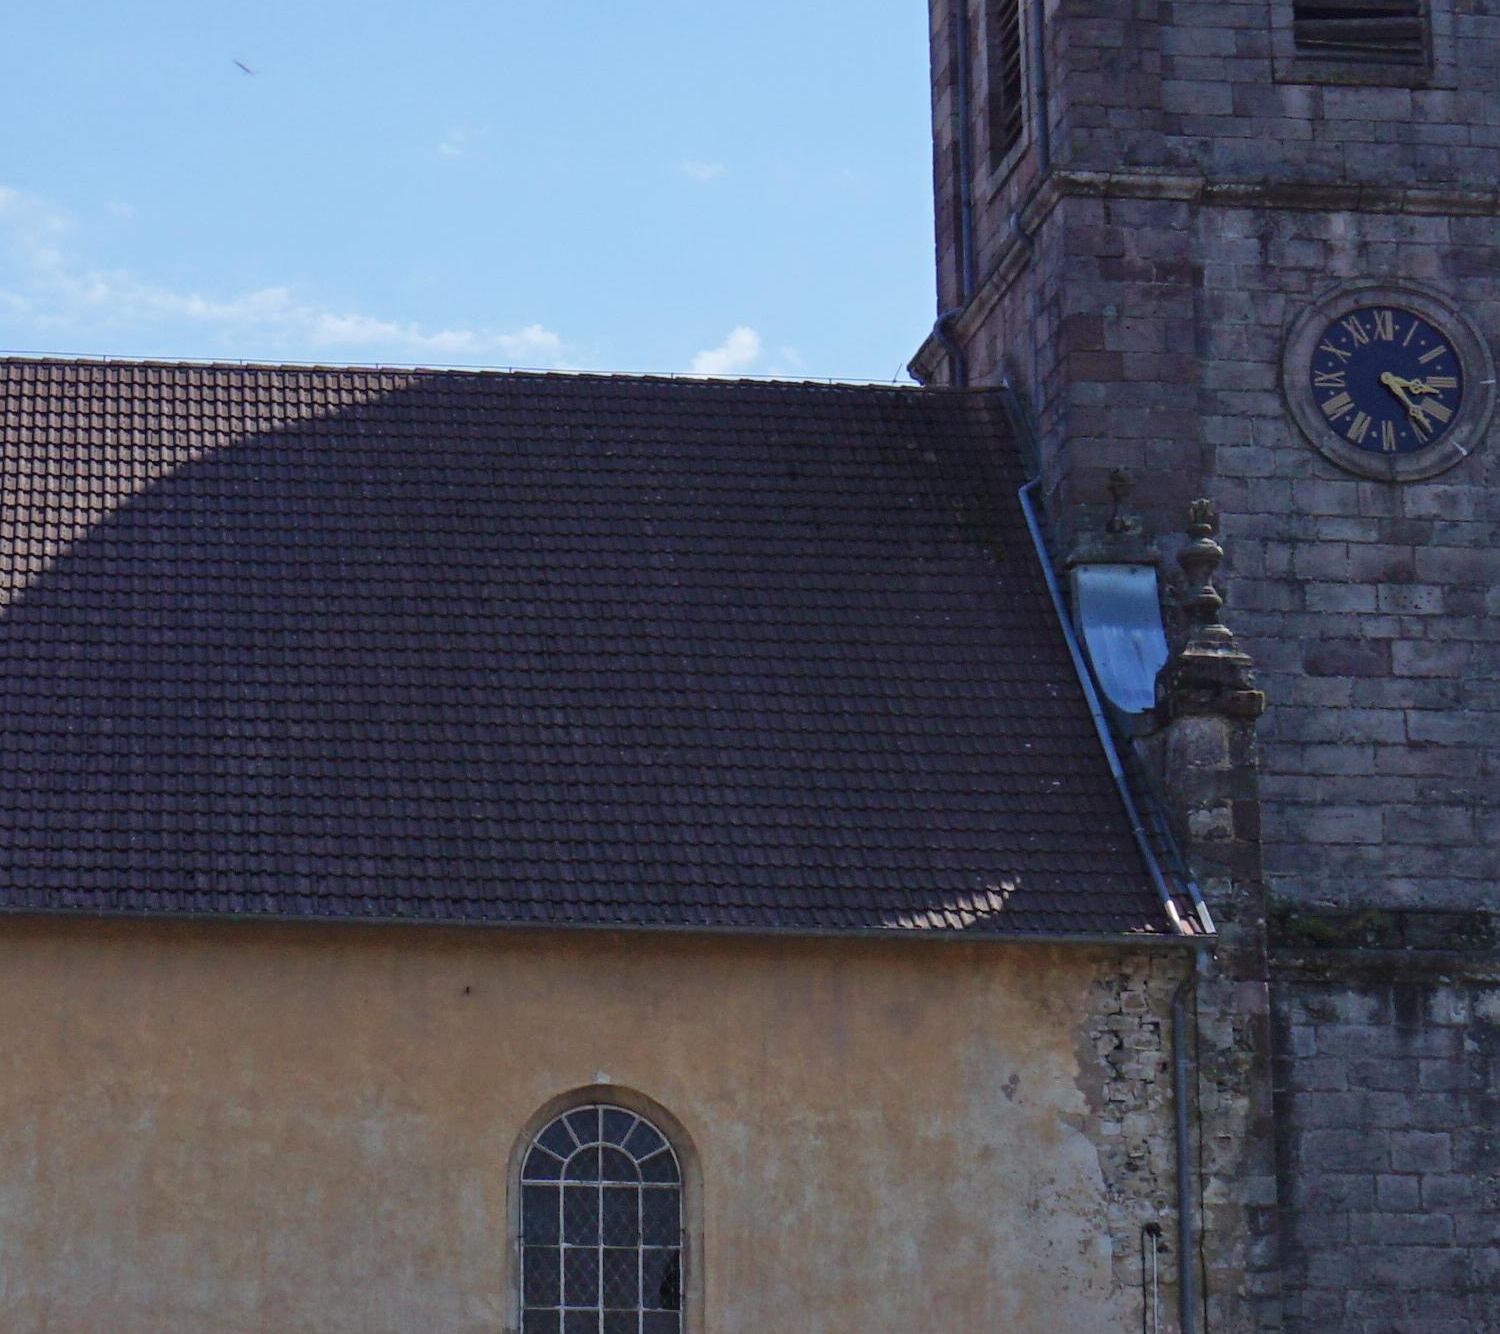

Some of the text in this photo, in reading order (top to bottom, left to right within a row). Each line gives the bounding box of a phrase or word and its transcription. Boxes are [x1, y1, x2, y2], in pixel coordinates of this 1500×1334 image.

[1341, 315, 1370, 349] XI
[1373, 310, 1394, 341] XII
[1402, 320, 1420, 347] I
[1319, 338, 1352, 364] X
[1417, 345, 1447, 365] II
[1314, 370, 1346, 388] IX
[1346, 410, 1372, 444] VII
[1381, 420, 1396, 452] VI
